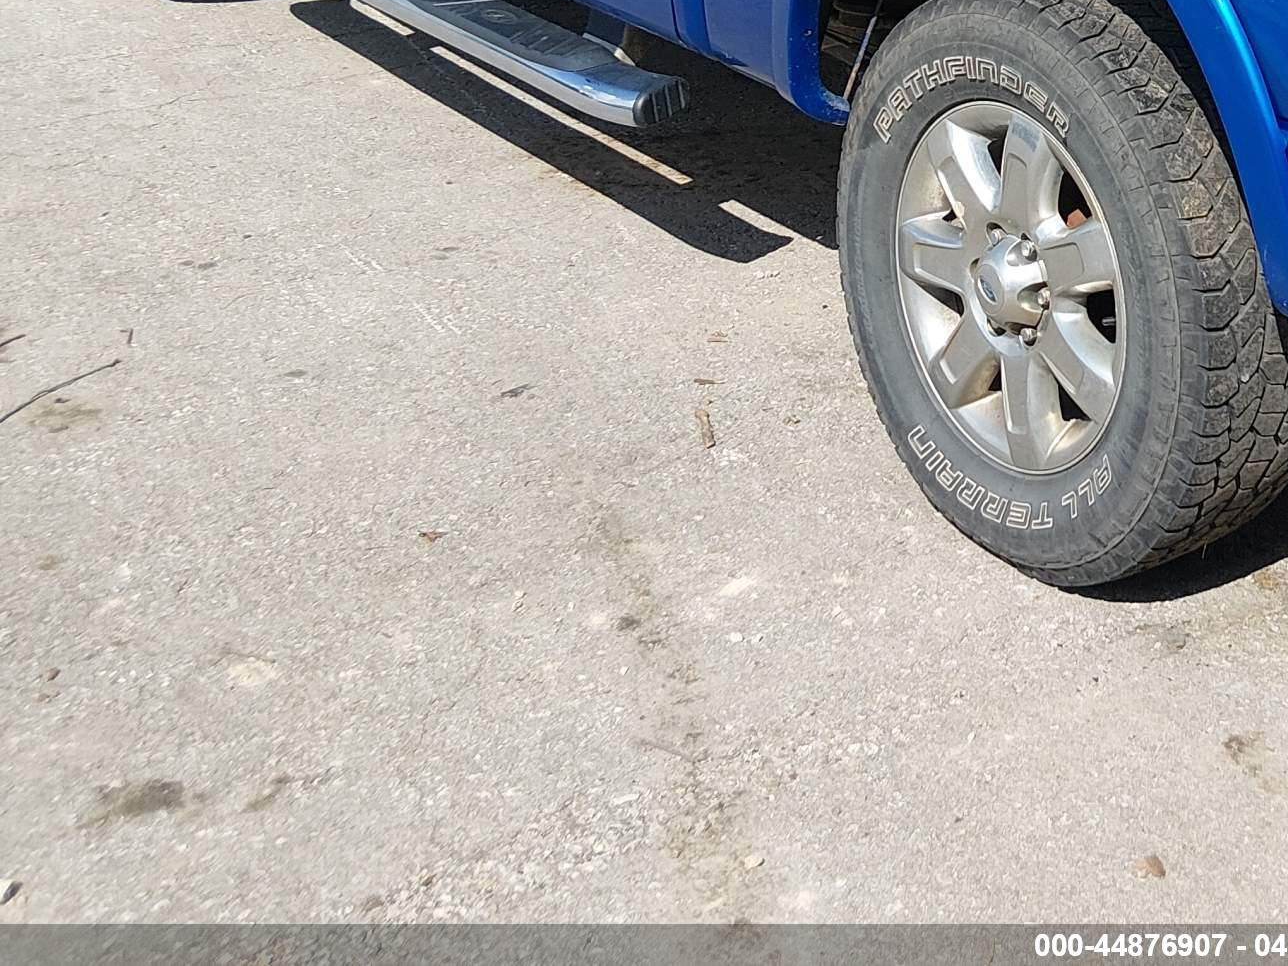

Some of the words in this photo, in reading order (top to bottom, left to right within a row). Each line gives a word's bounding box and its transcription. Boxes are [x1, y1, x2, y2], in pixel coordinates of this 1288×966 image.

[872, 55, 1070, 144] PATHFINDER
[907, 424, 1054, 530] TERRAIN
[1061, 454, 1113, 519] ALL
